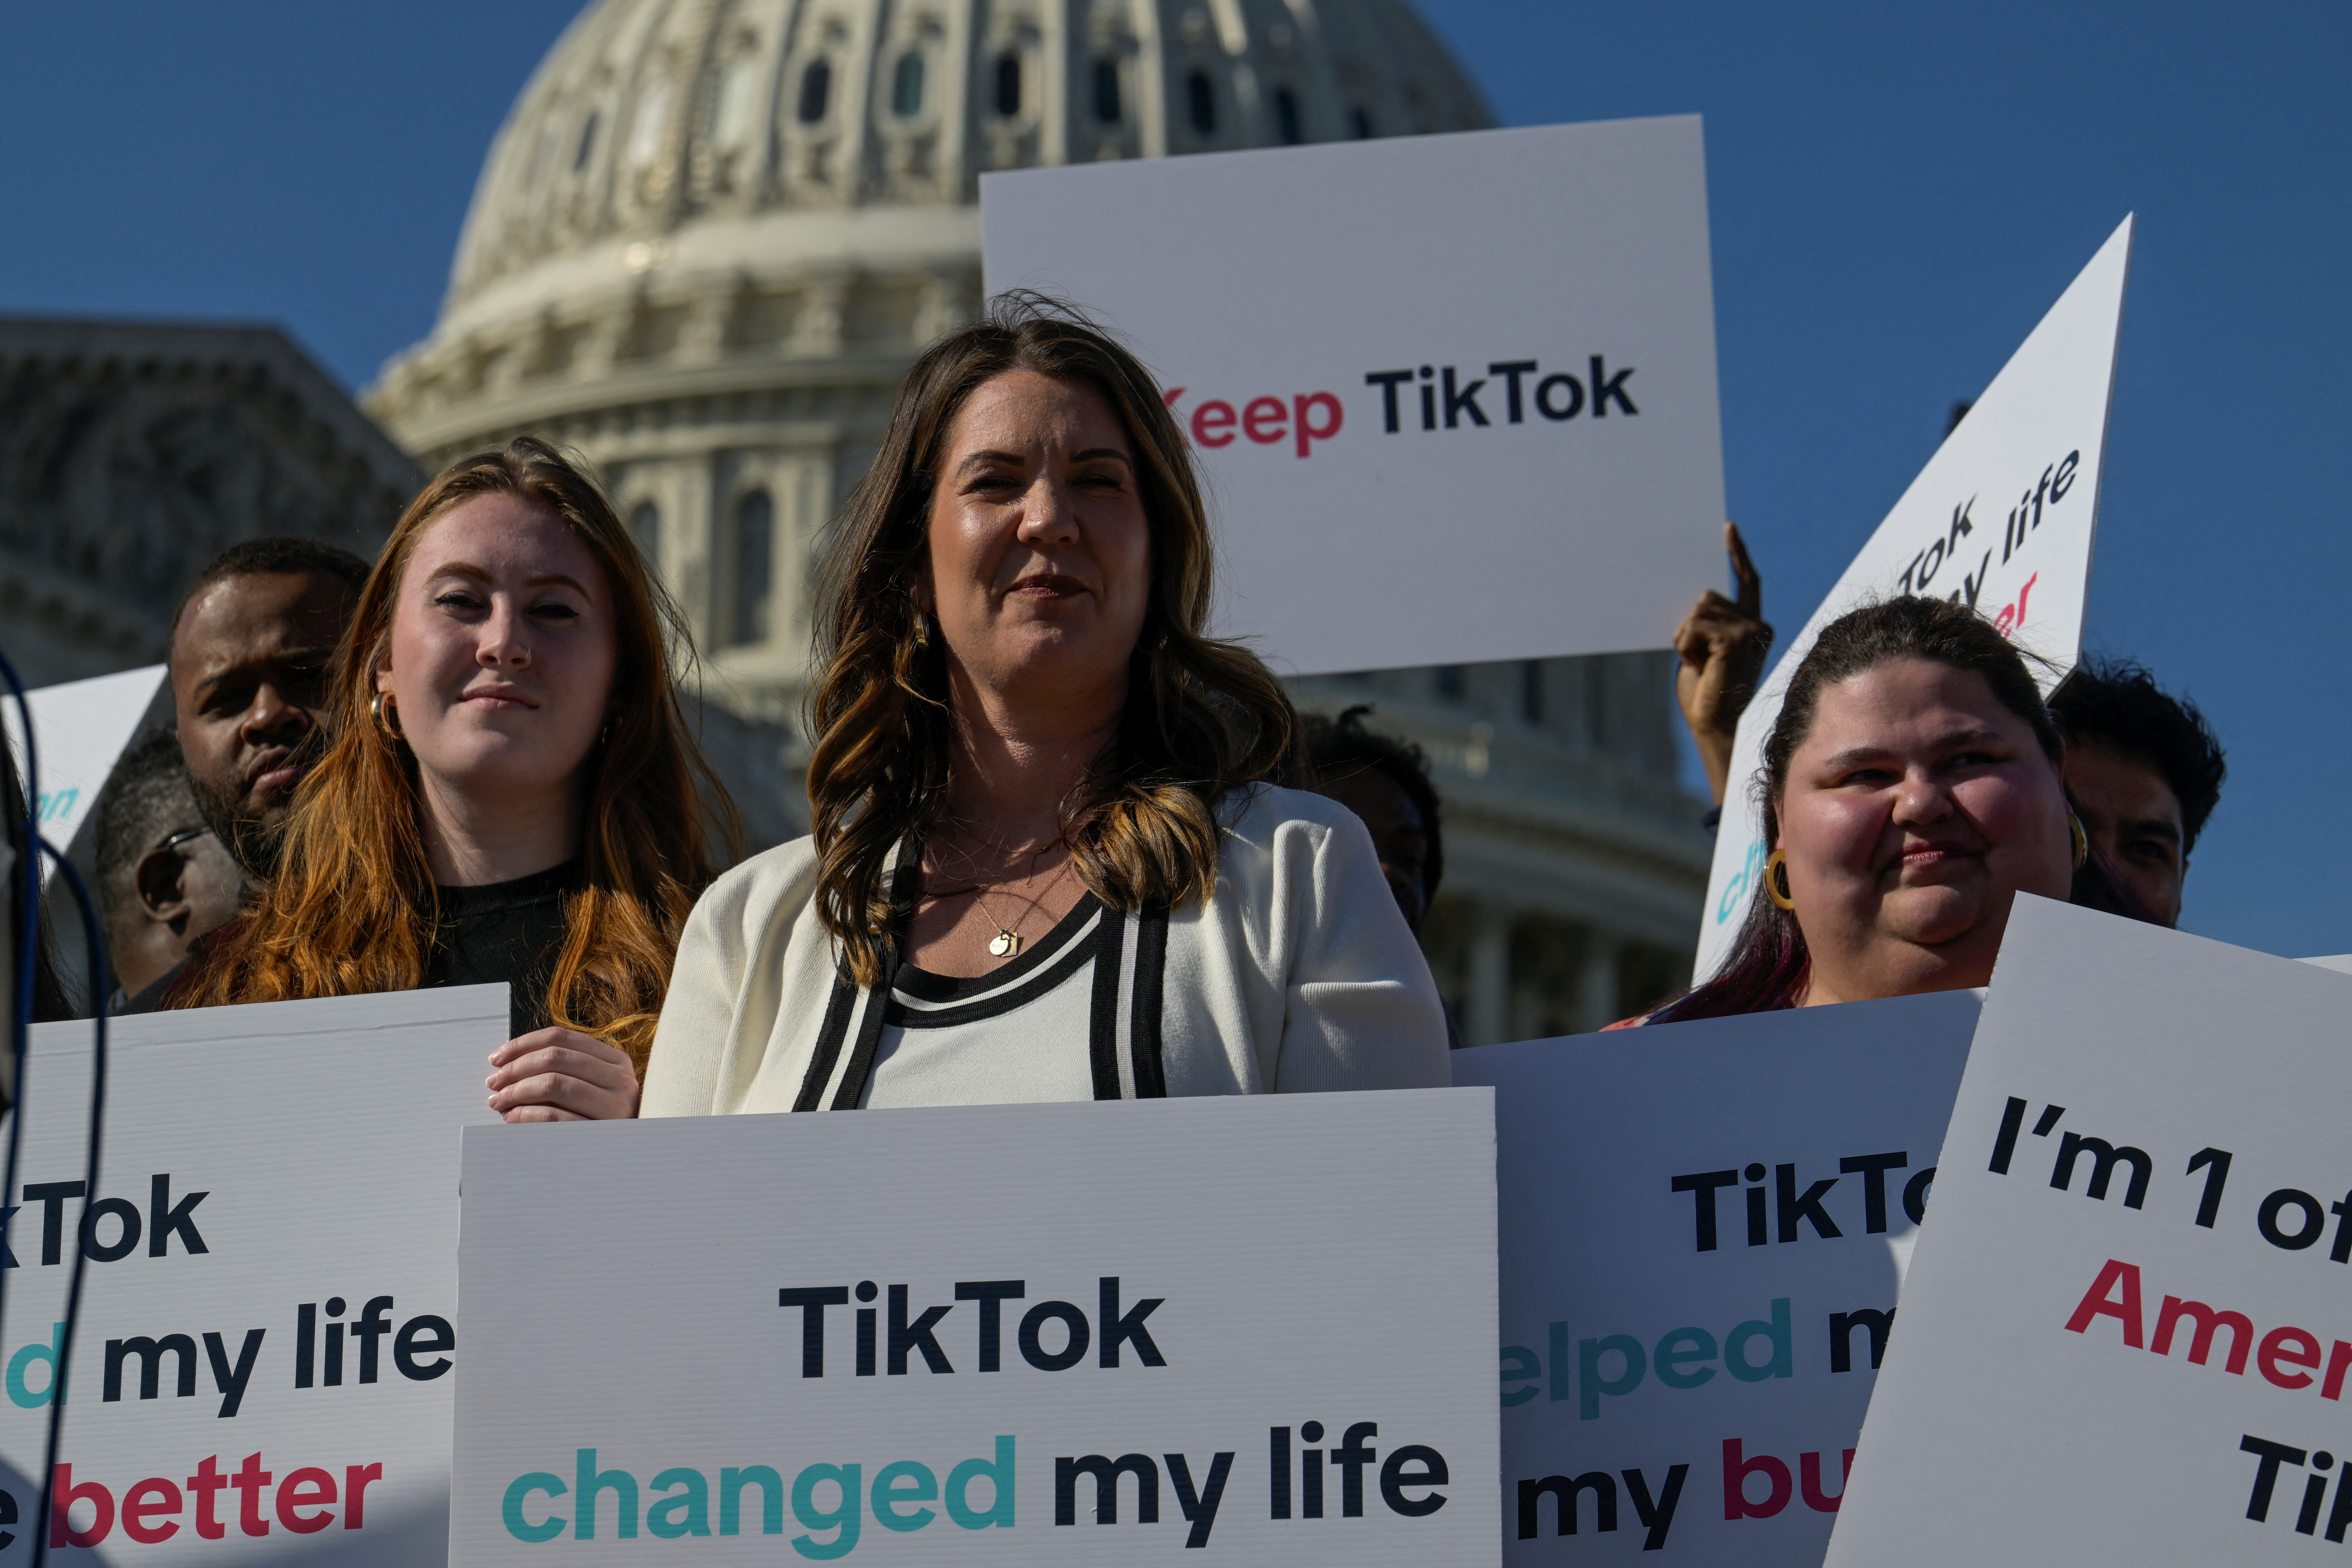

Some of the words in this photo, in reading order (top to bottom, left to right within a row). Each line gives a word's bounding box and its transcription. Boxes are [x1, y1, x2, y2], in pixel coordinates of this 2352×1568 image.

[1365, 355, 1639, 434] TikTok
[2003, 450, 2079, 566] life
[1988, 1096, 2152, 1210] I'm
[2186, 1147, 2233, 1229] 1
[103, 1329, 266, 1418] my
[296, 1296, 455, 1388] life
[779, 1276, 1167, 1378] TikTok
[2064, 1259, 2352, 1401] Amer
[50, 1452, 383, 1548] better
[502, 1435, 1016, 1561] changed
[1055, 1452, 1236, 1548] my
[1270, 1421, 1449, 1520] life
[1517, 1464, 1690, 1552] my
